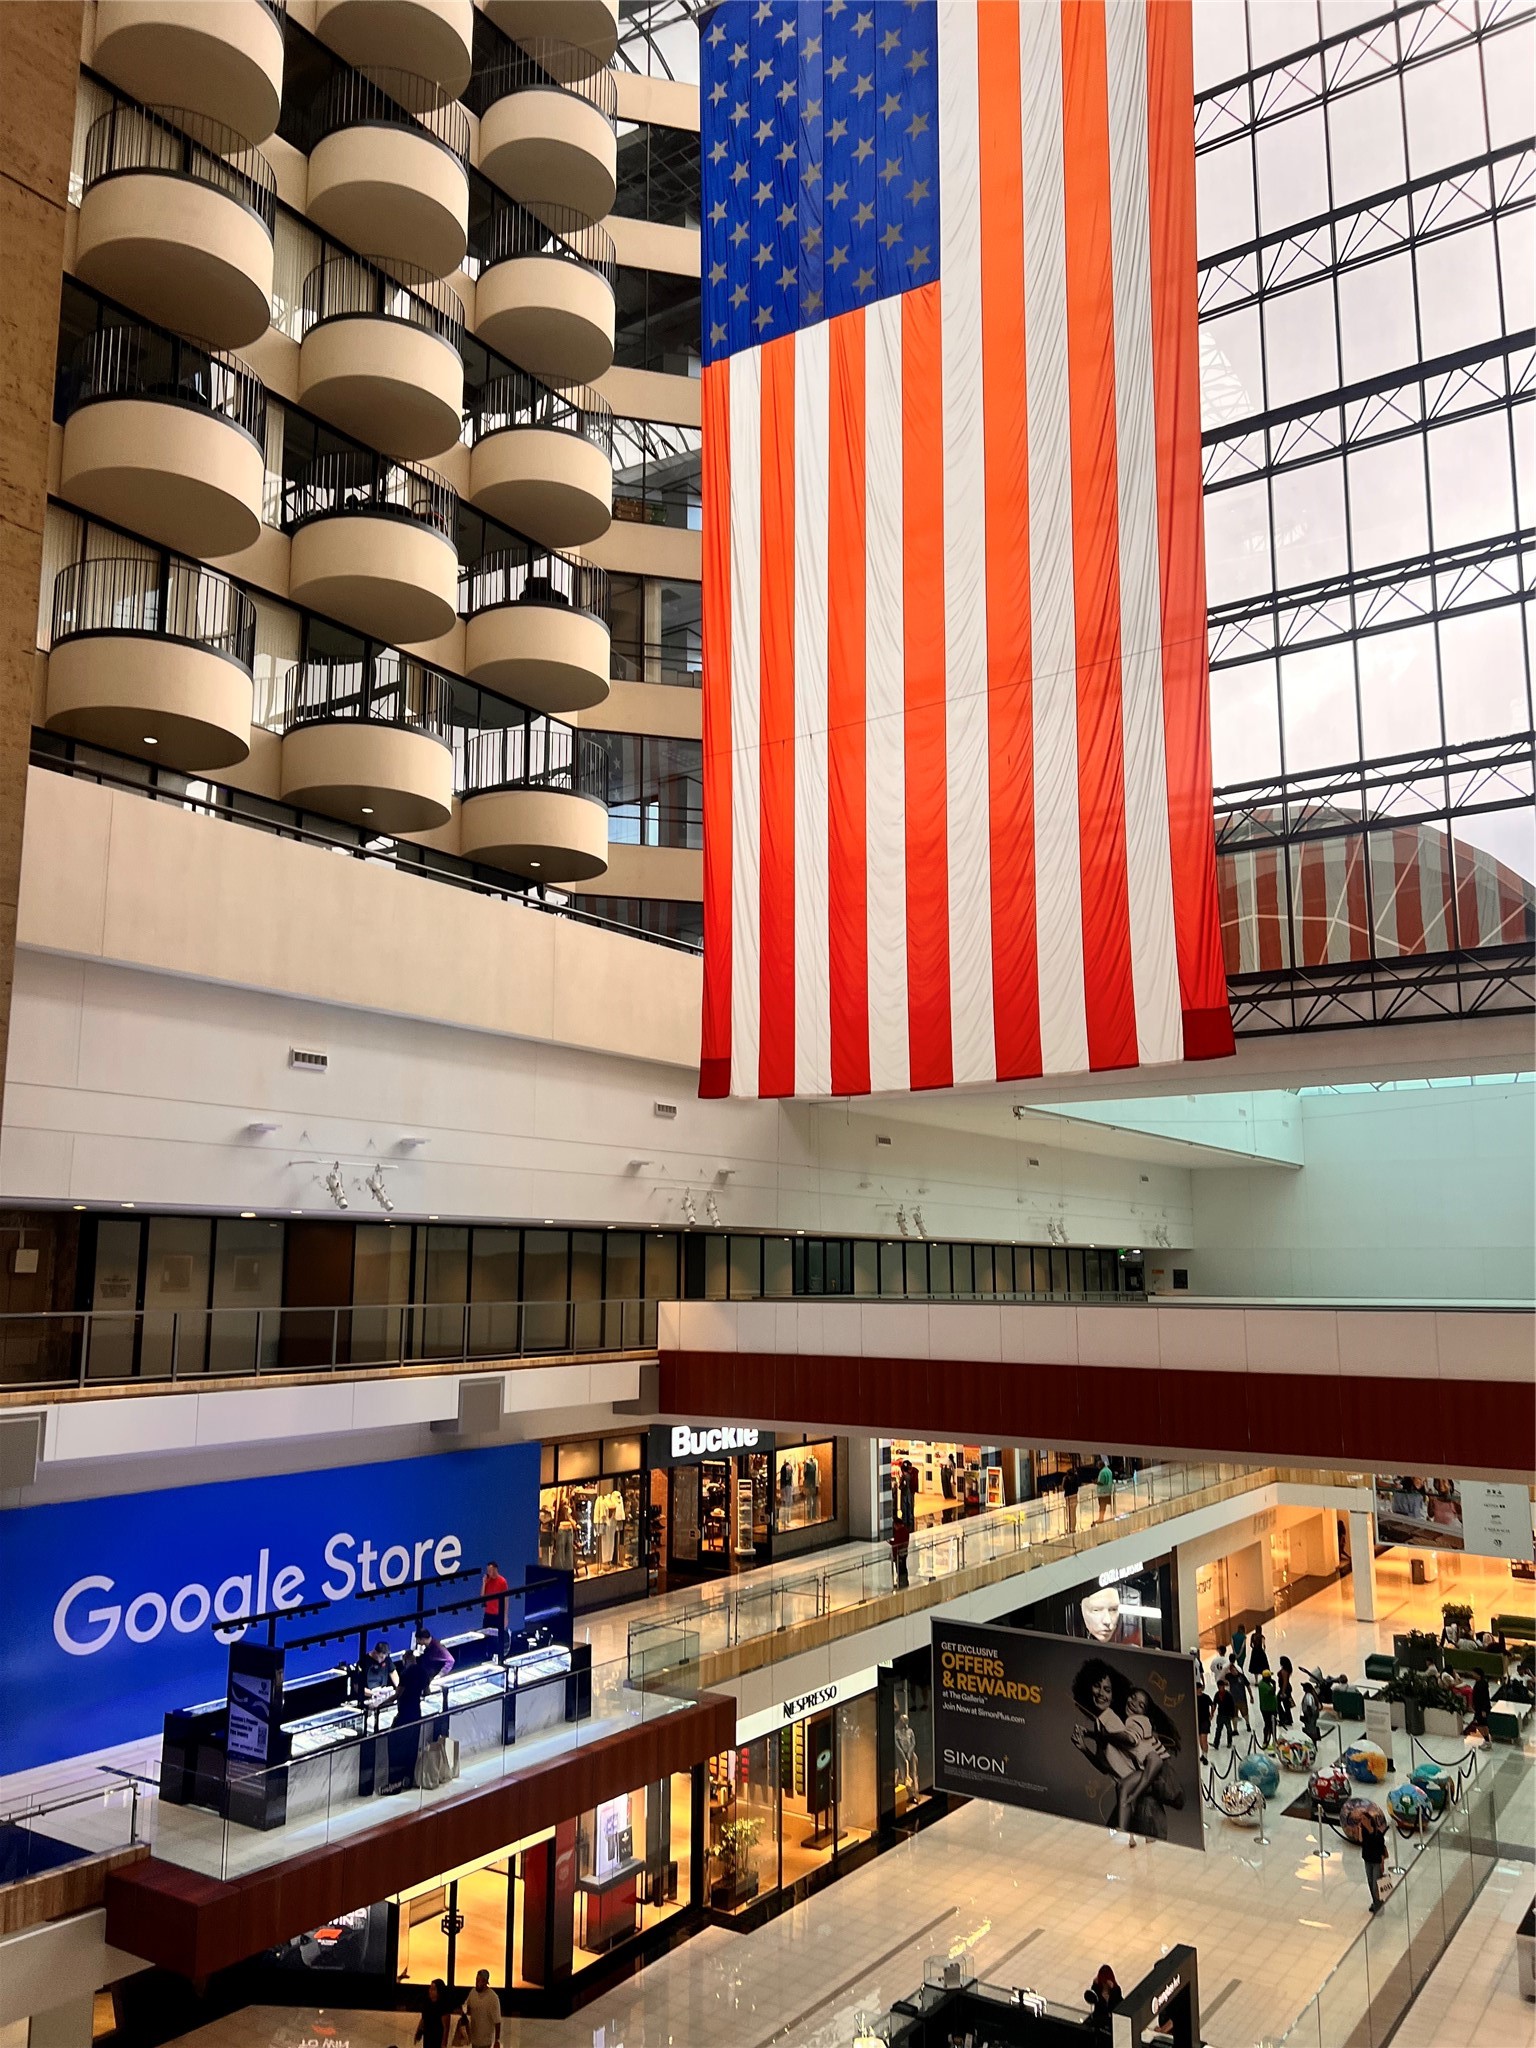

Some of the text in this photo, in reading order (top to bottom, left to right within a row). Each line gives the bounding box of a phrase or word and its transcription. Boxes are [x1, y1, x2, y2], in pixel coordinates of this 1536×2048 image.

[671, 1425, 759, 1458] Buckle
[53, 1532, 462, 1656] Google Store
[941, 1641, 998, 1659] GET EXCLUSIVE
[941, 1651, 1005, 1678] OFFERS
[942, 1670, 955, 1688] &
[783, 1685, 837, 1719] NESPRESSO
[942, 1690, 949, 1698] at
[949, 1690, 961, 1700] The
[942, 1701, 1026, 1725] Join Now at SimonPlus.com
